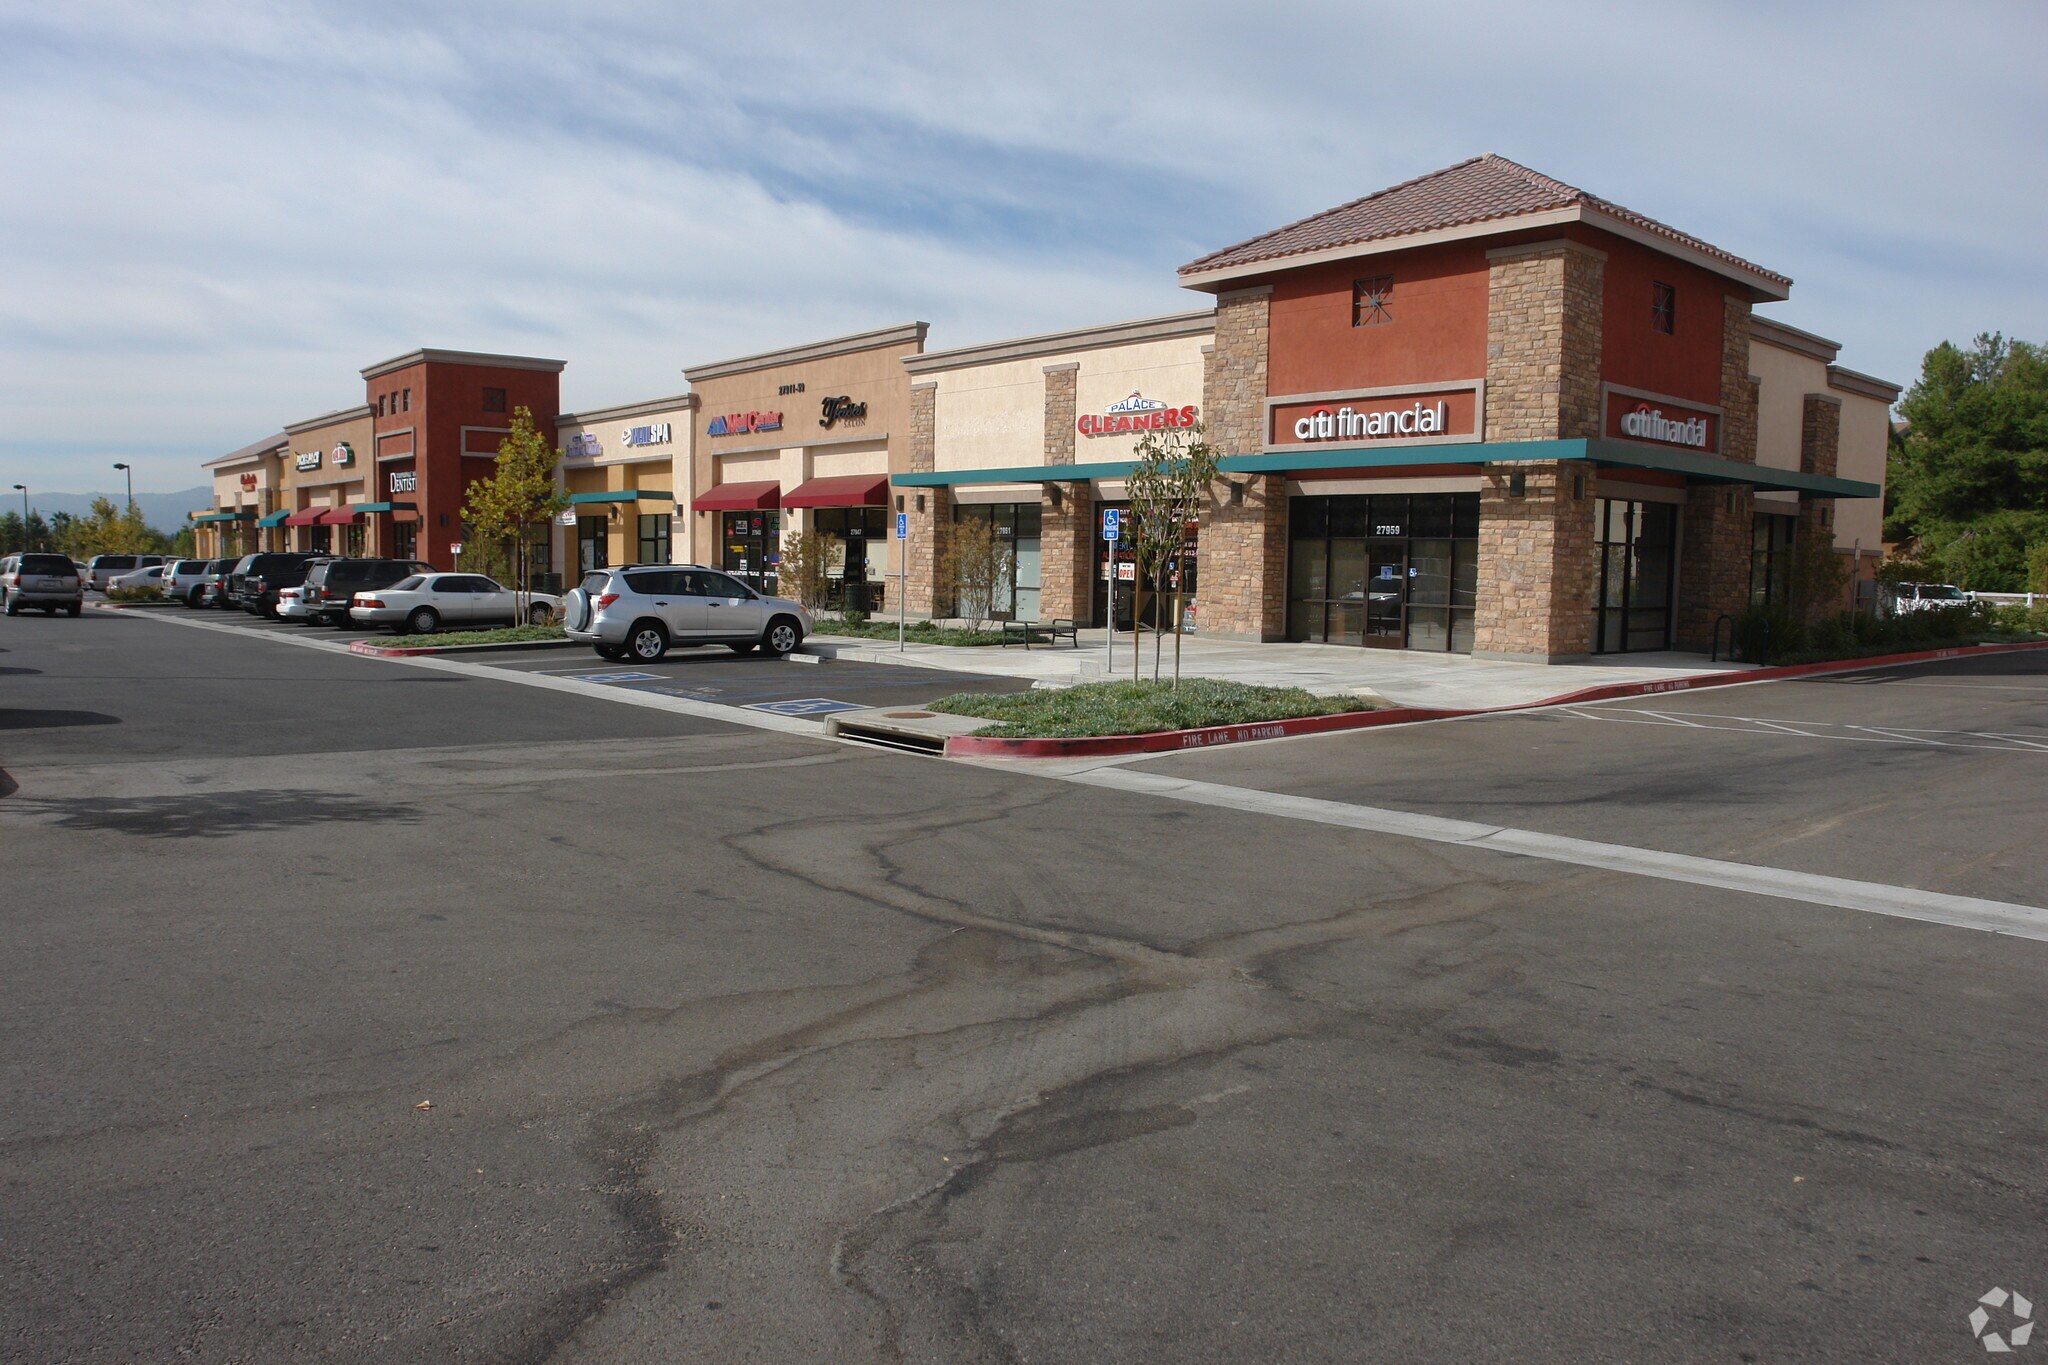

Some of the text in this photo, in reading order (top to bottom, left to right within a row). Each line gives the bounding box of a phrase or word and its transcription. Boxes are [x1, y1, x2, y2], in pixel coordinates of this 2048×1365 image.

[1111, 399, 1156, 412] PALACE
[748, 410, 780, 431] Center
[843, 419, 866, 429] SALON
[1077, 405, 1195, 435] CLEANERS
[1376, 525, 1400, 535] 27959
[1119, 569, 1133, 578] OPEN
[1182, 725, 1285, 747] FIRE LANE NO PARKING
